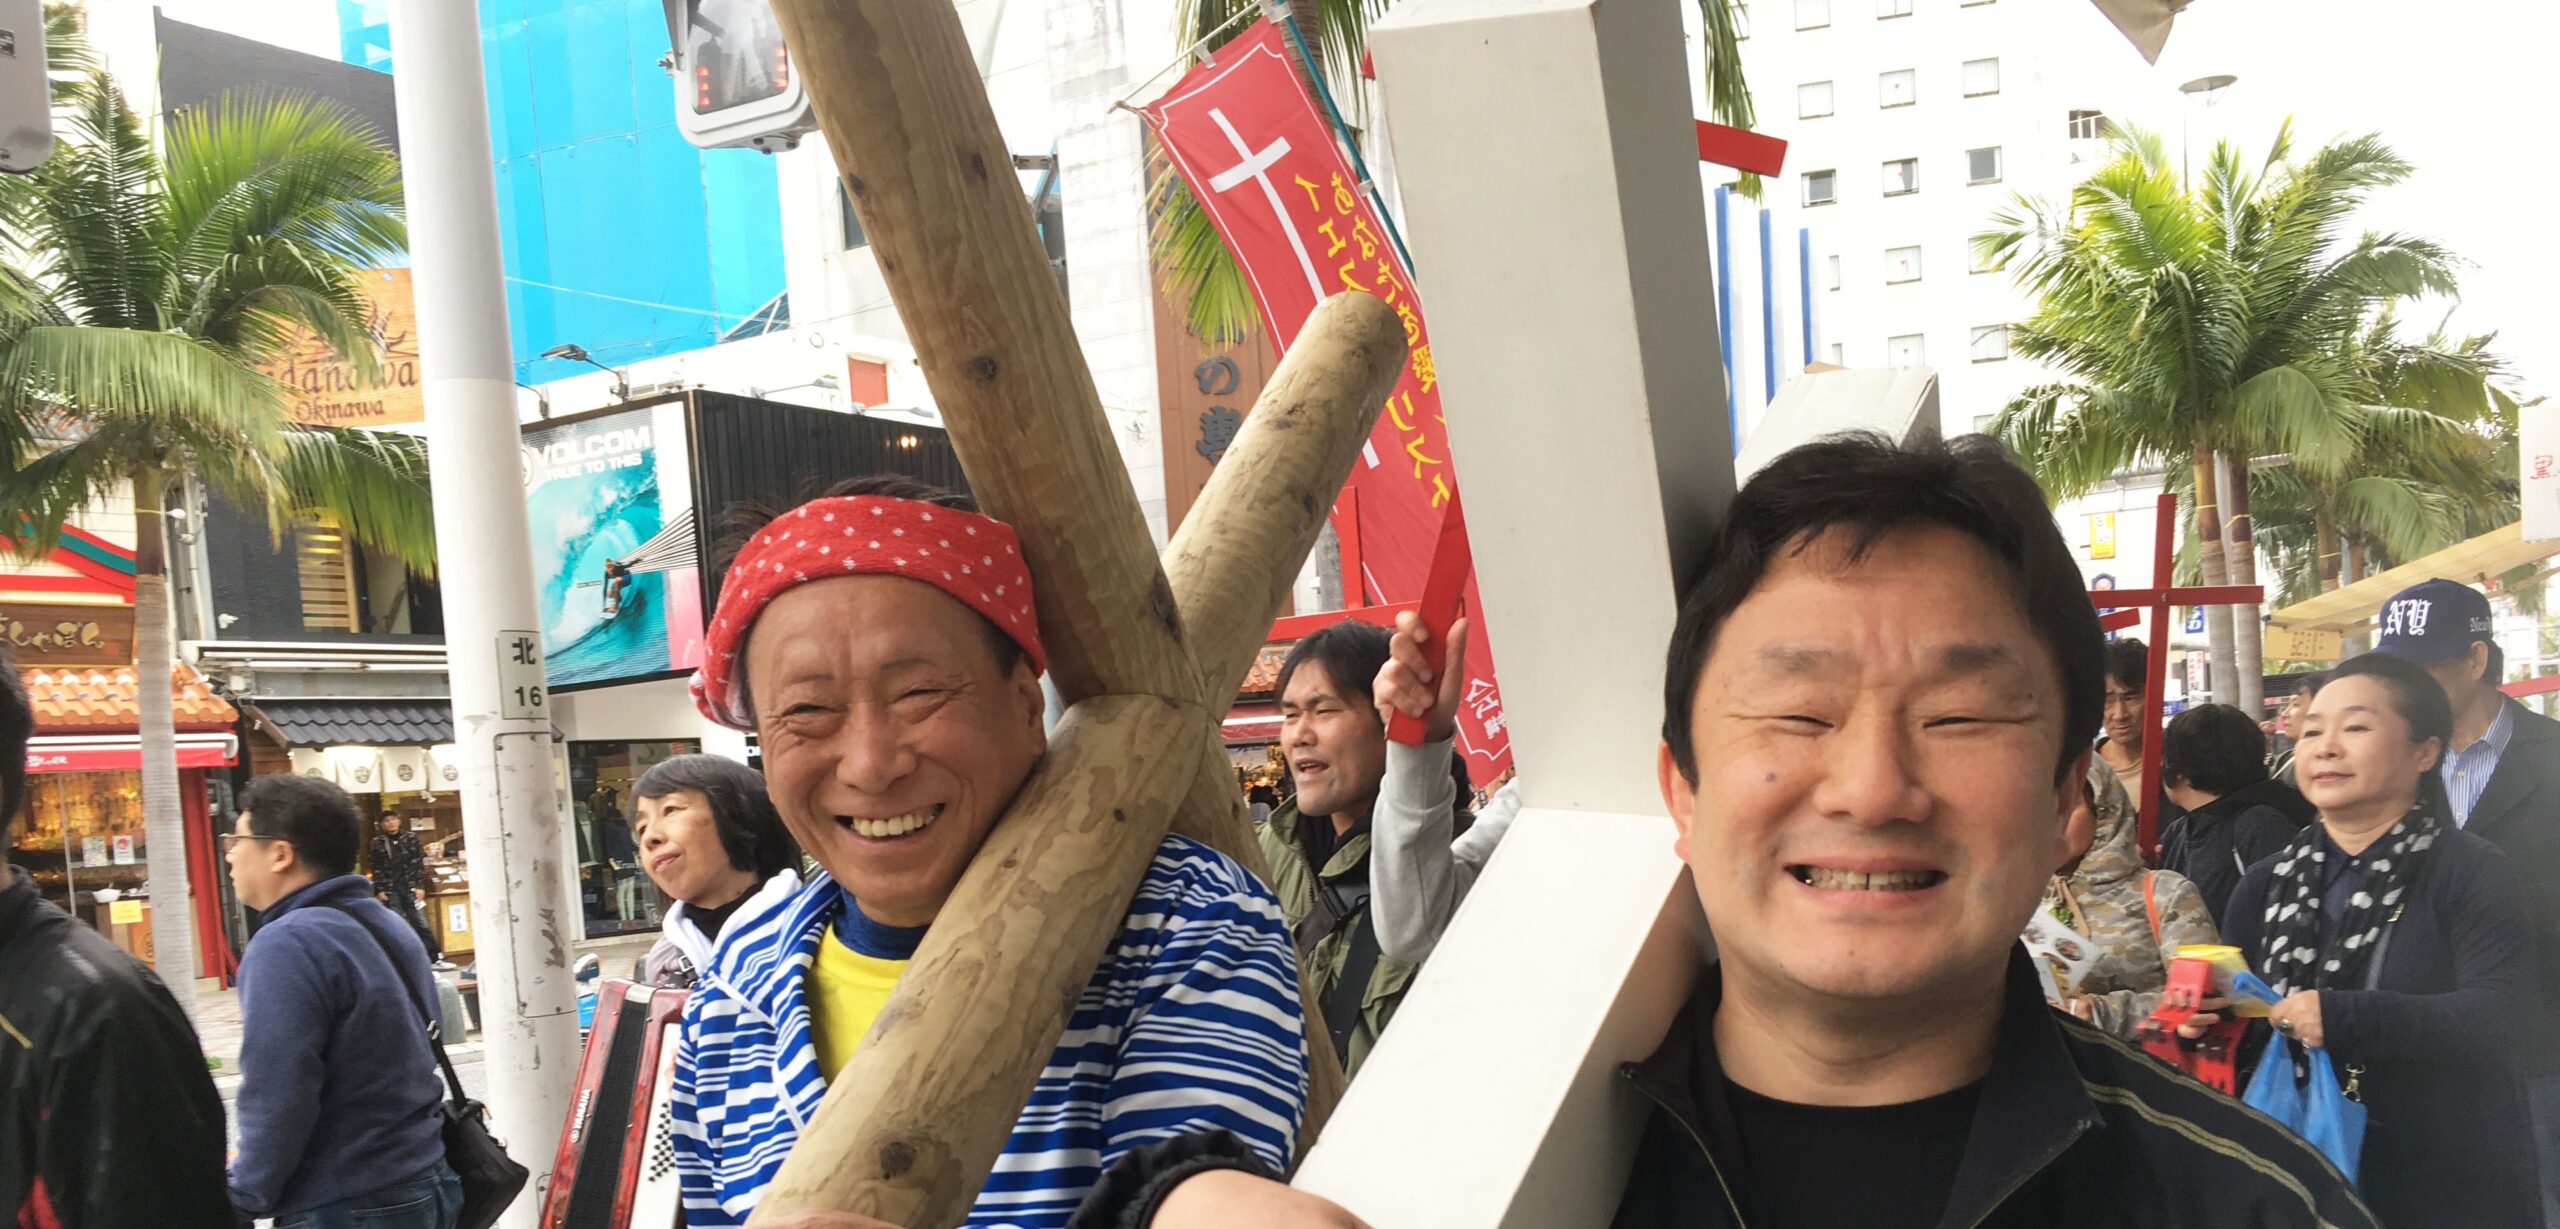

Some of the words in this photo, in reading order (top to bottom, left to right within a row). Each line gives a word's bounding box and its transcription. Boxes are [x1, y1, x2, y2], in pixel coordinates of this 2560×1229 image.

[295, 395, 385, 424] Okinawa
[530, 425, 652, 468] VOLCOM
[584, 459, 605, 474] TO
[607, 453, 643, 470] THIS
[2383, 598, 2433, 637] NY
[511, 636, 537, 665] 北
[514, 685, 543, 707] 16
[572, 1088, 592, 1130] YAMAHA
